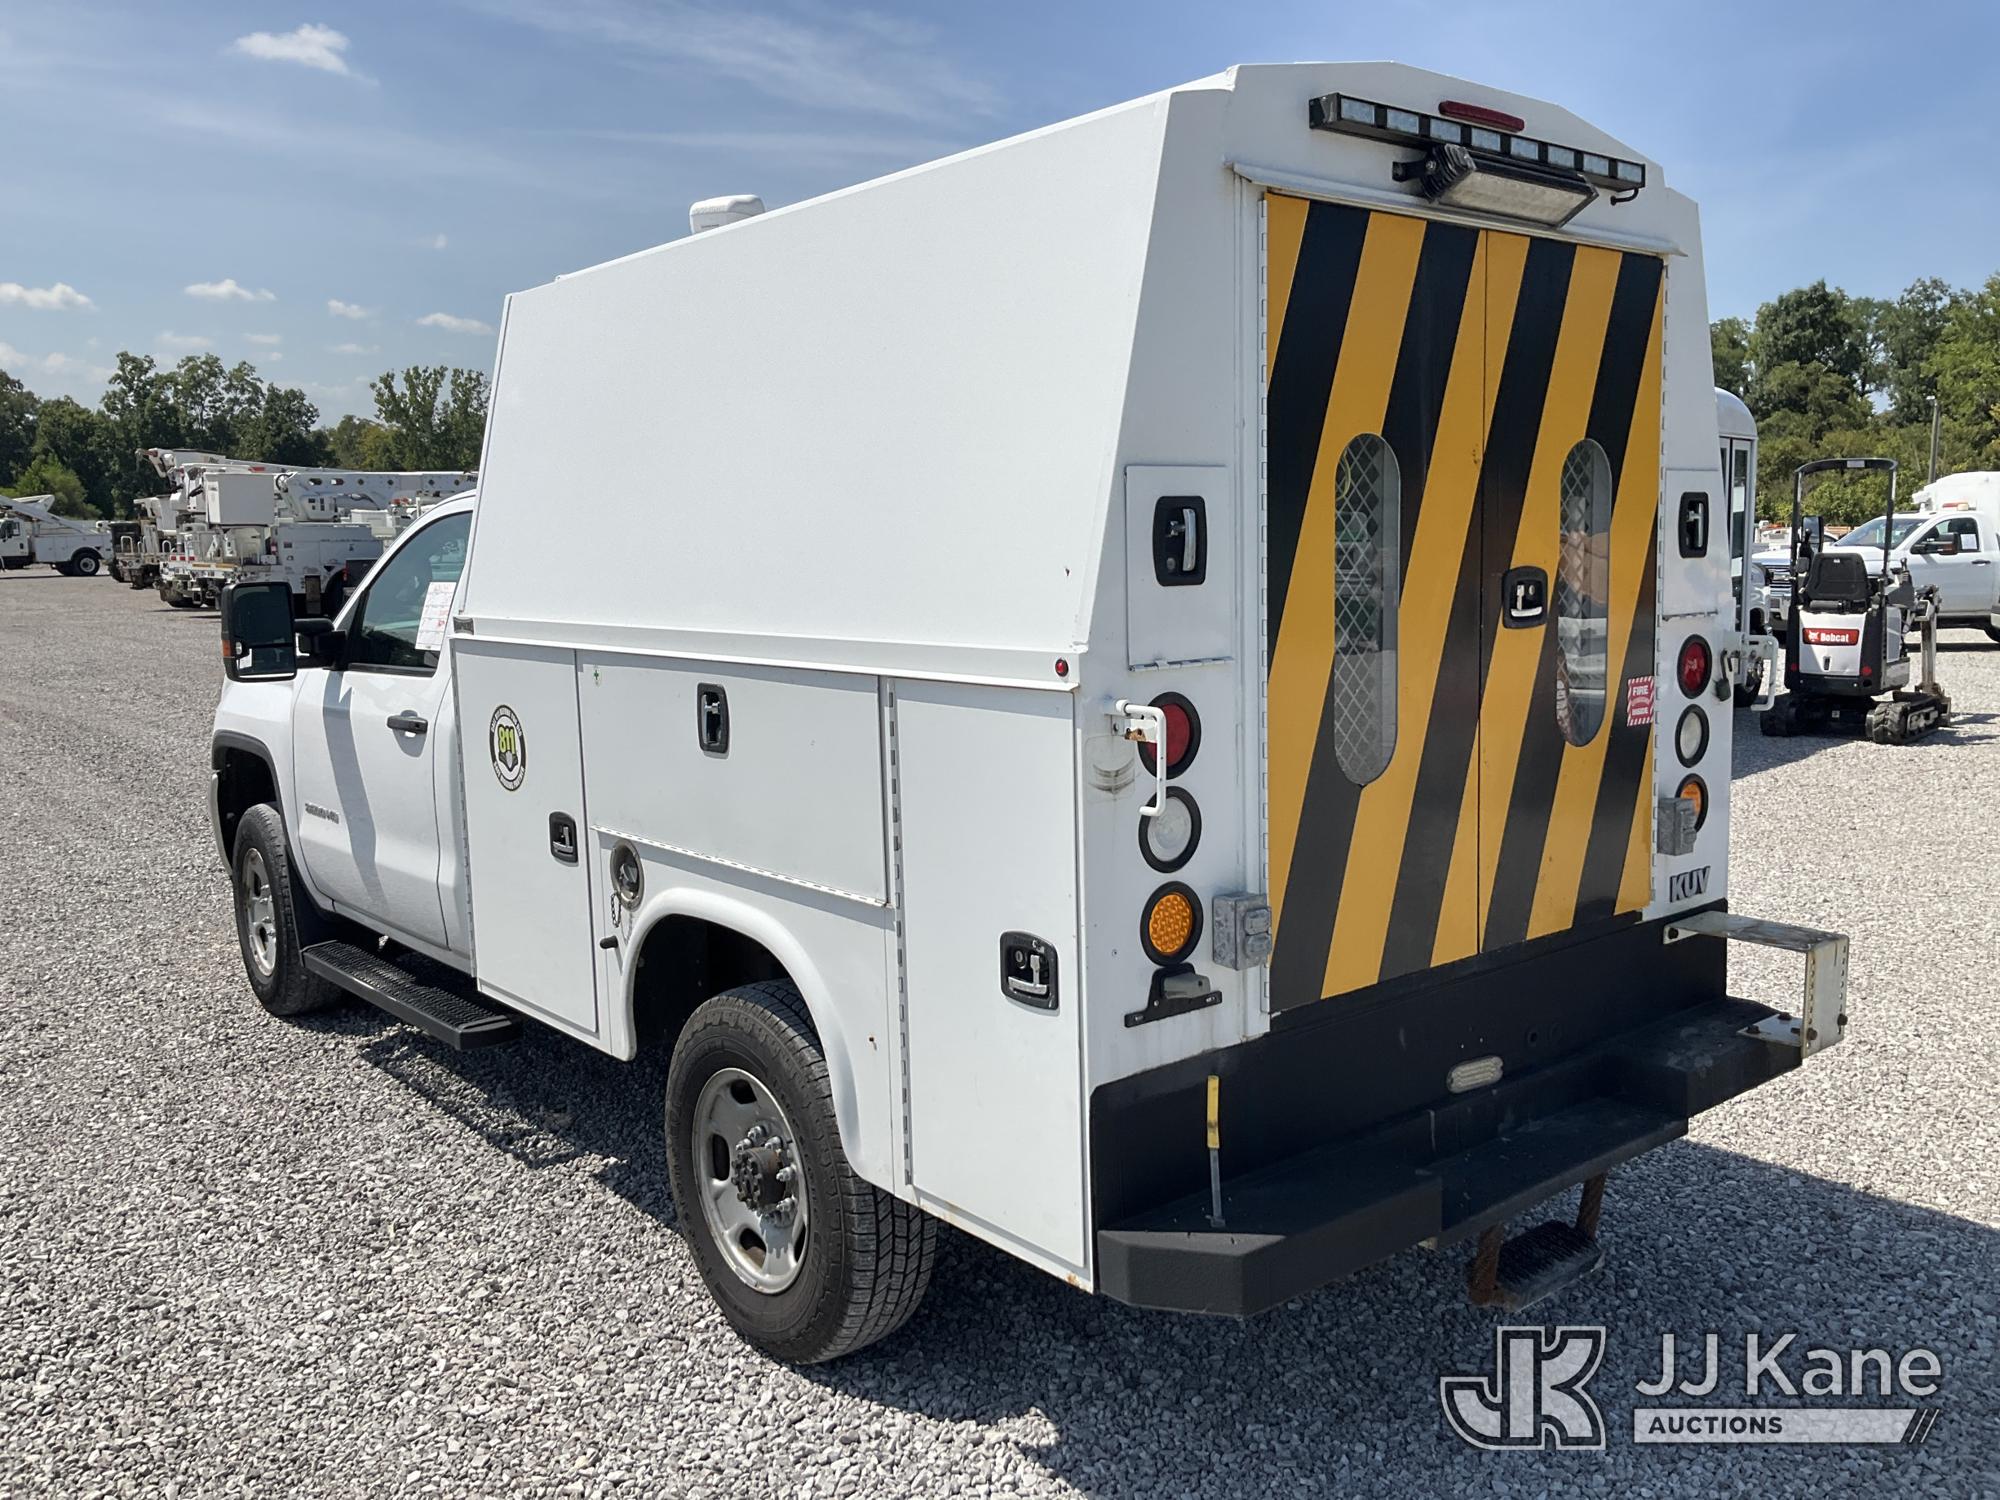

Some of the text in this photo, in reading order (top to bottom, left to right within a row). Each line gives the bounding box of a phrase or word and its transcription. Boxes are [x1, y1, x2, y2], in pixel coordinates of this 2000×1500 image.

[1820, 633, 1849, 642] Bobcat
[1632, 685, 1649, 696] FIRE
[498, 725, 516, 754] 811
[1670, 866, 1711, 902] KUV
